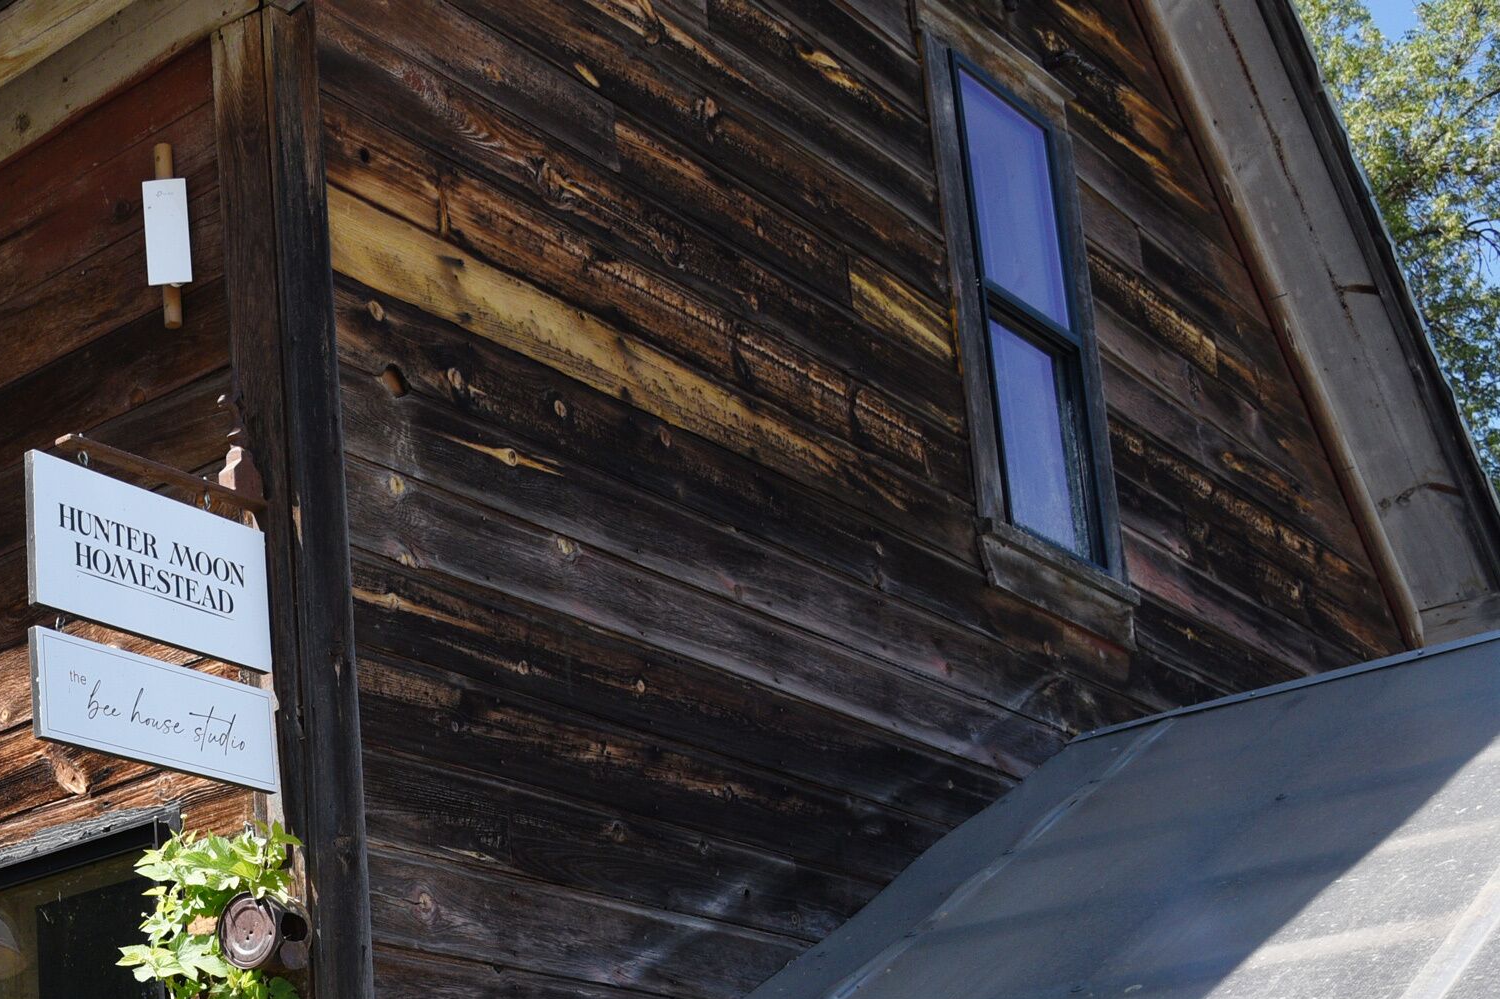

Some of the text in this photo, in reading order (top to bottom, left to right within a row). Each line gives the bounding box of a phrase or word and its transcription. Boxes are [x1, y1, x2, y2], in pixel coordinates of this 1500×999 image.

[58, 503, 245, 588] HUNTER MOON
[75, 541, 234, 614] HOMESTEAD
[69, 670, 246, 756] the bee house studio
